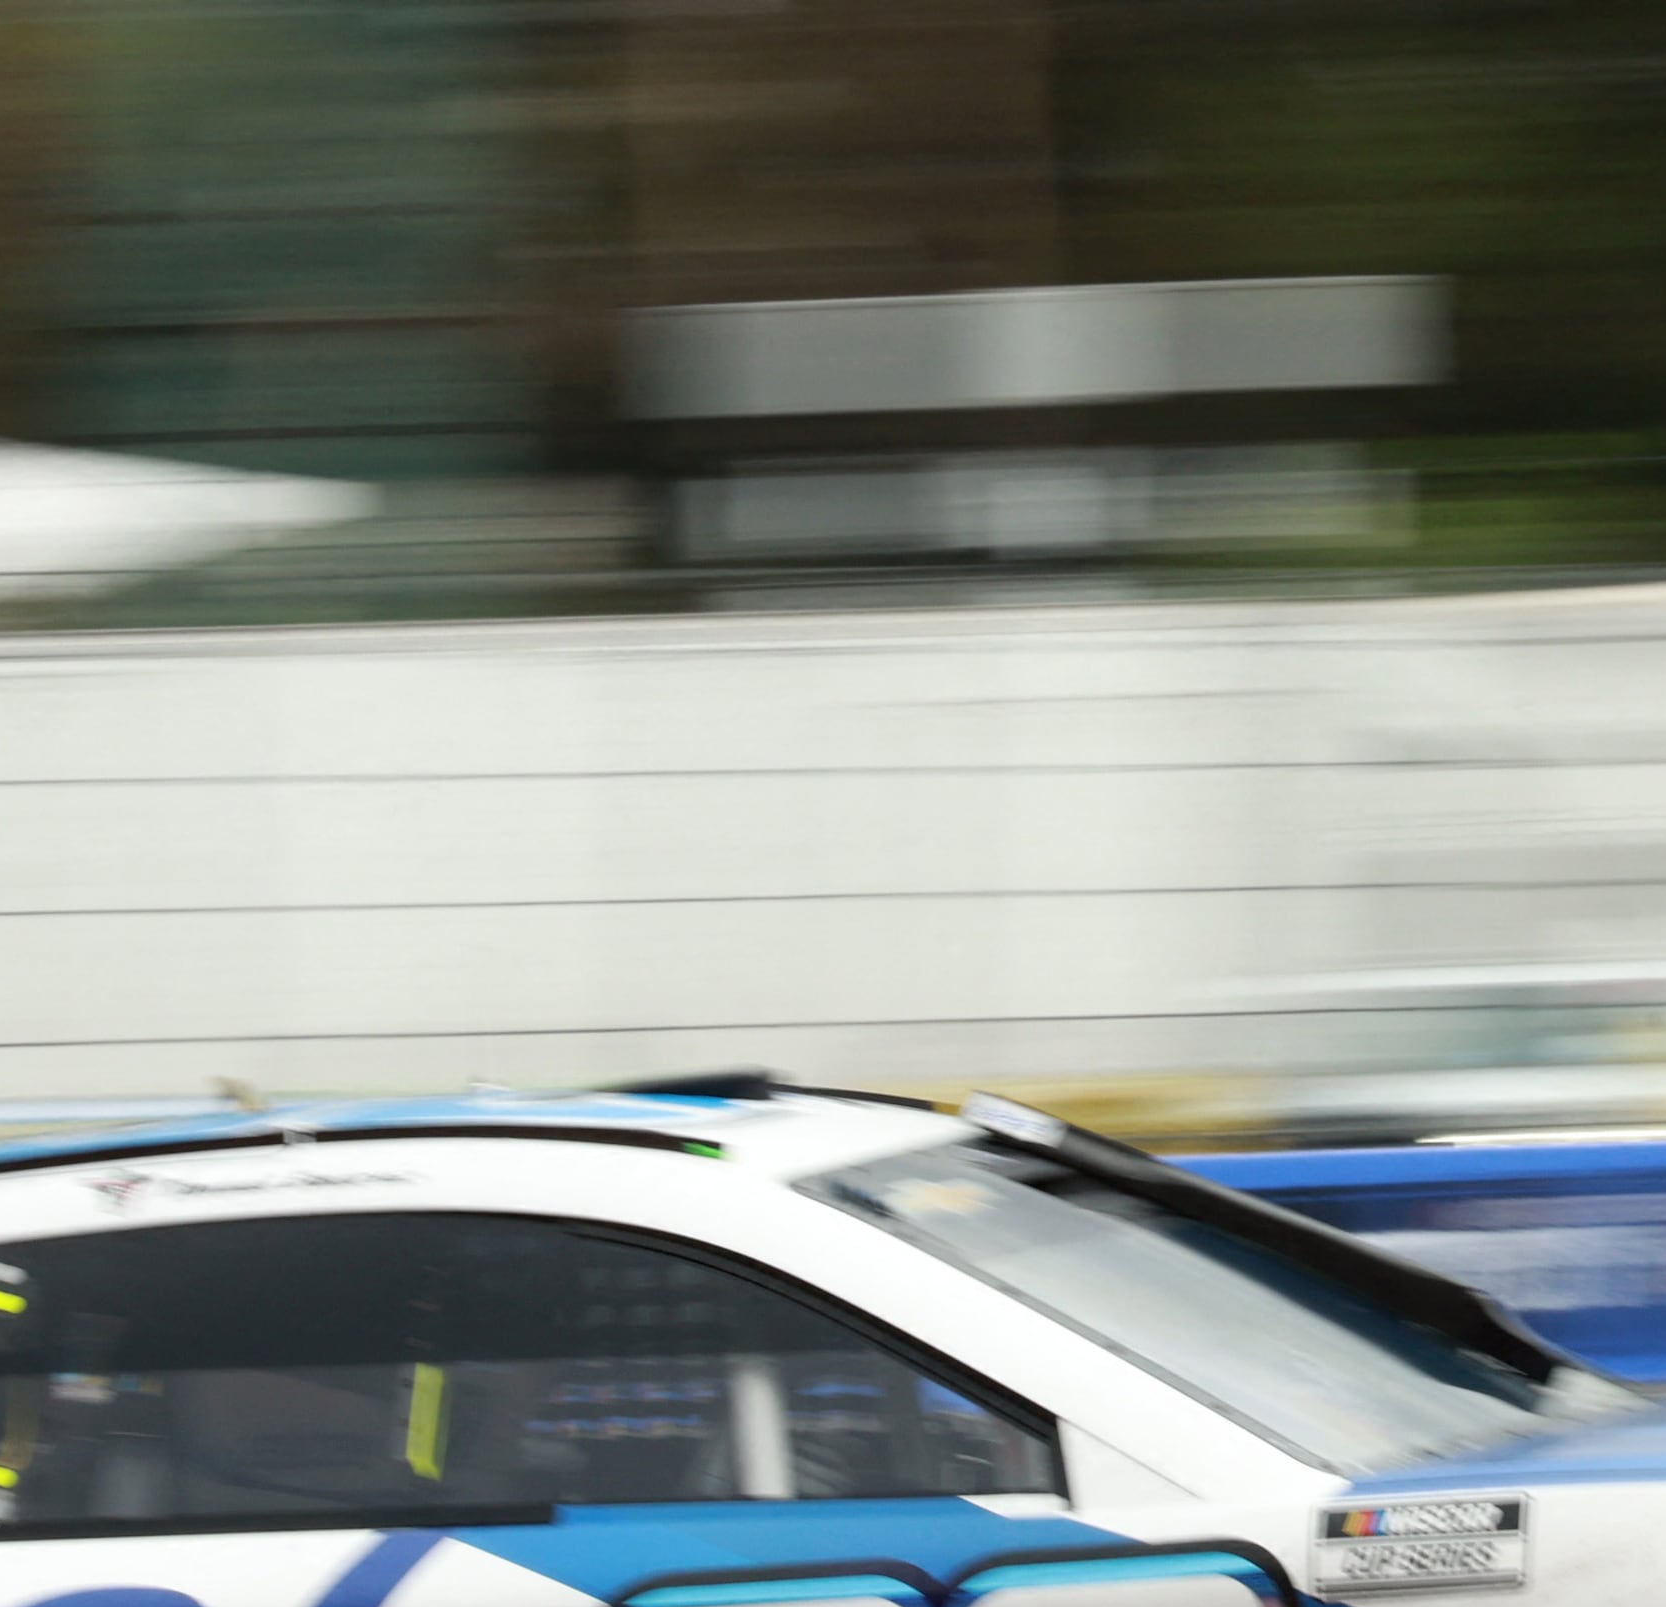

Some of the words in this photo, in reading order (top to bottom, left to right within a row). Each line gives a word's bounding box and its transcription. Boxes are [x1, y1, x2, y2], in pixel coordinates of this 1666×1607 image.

[1379, 1502, 1505, 1537] NASCAR
[1341, 1543, 1397, 1580] CUP
[1402, 1540, 1498, 1577] SERIES
